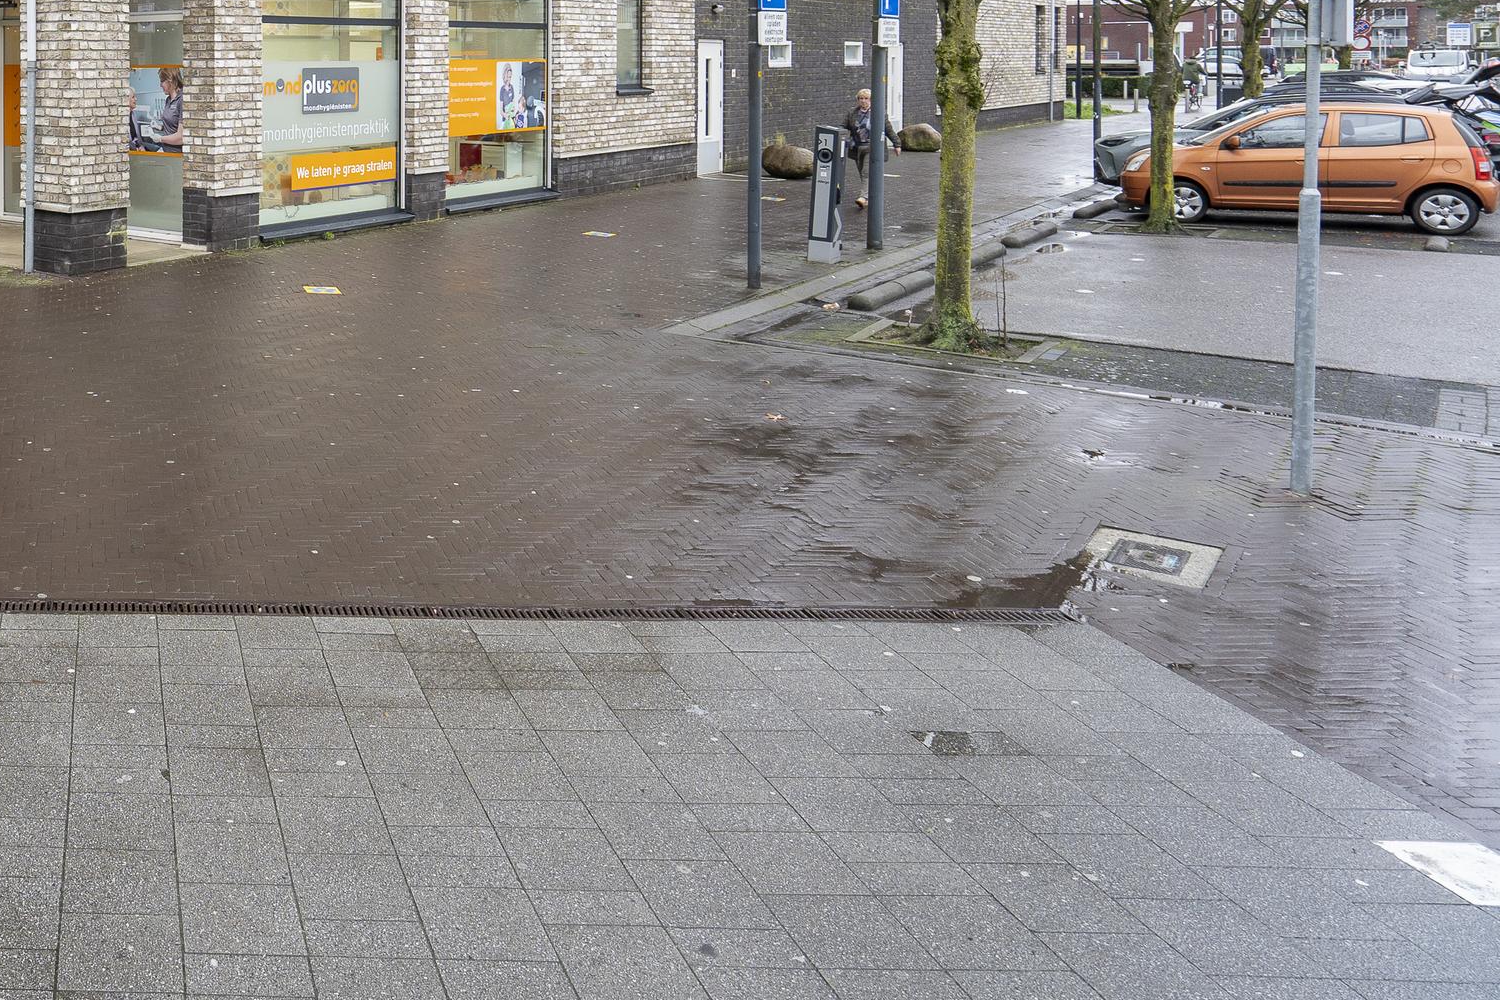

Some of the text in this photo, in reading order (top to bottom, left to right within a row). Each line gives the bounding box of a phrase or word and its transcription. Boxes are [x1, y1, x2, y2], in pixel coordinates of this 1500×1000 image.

[1480, 29, 1492, 41] P
[263, 117, 390, 144] mondhygiënistenpraktijk
[296, 159, 393, 180] We laten je graag stralen
